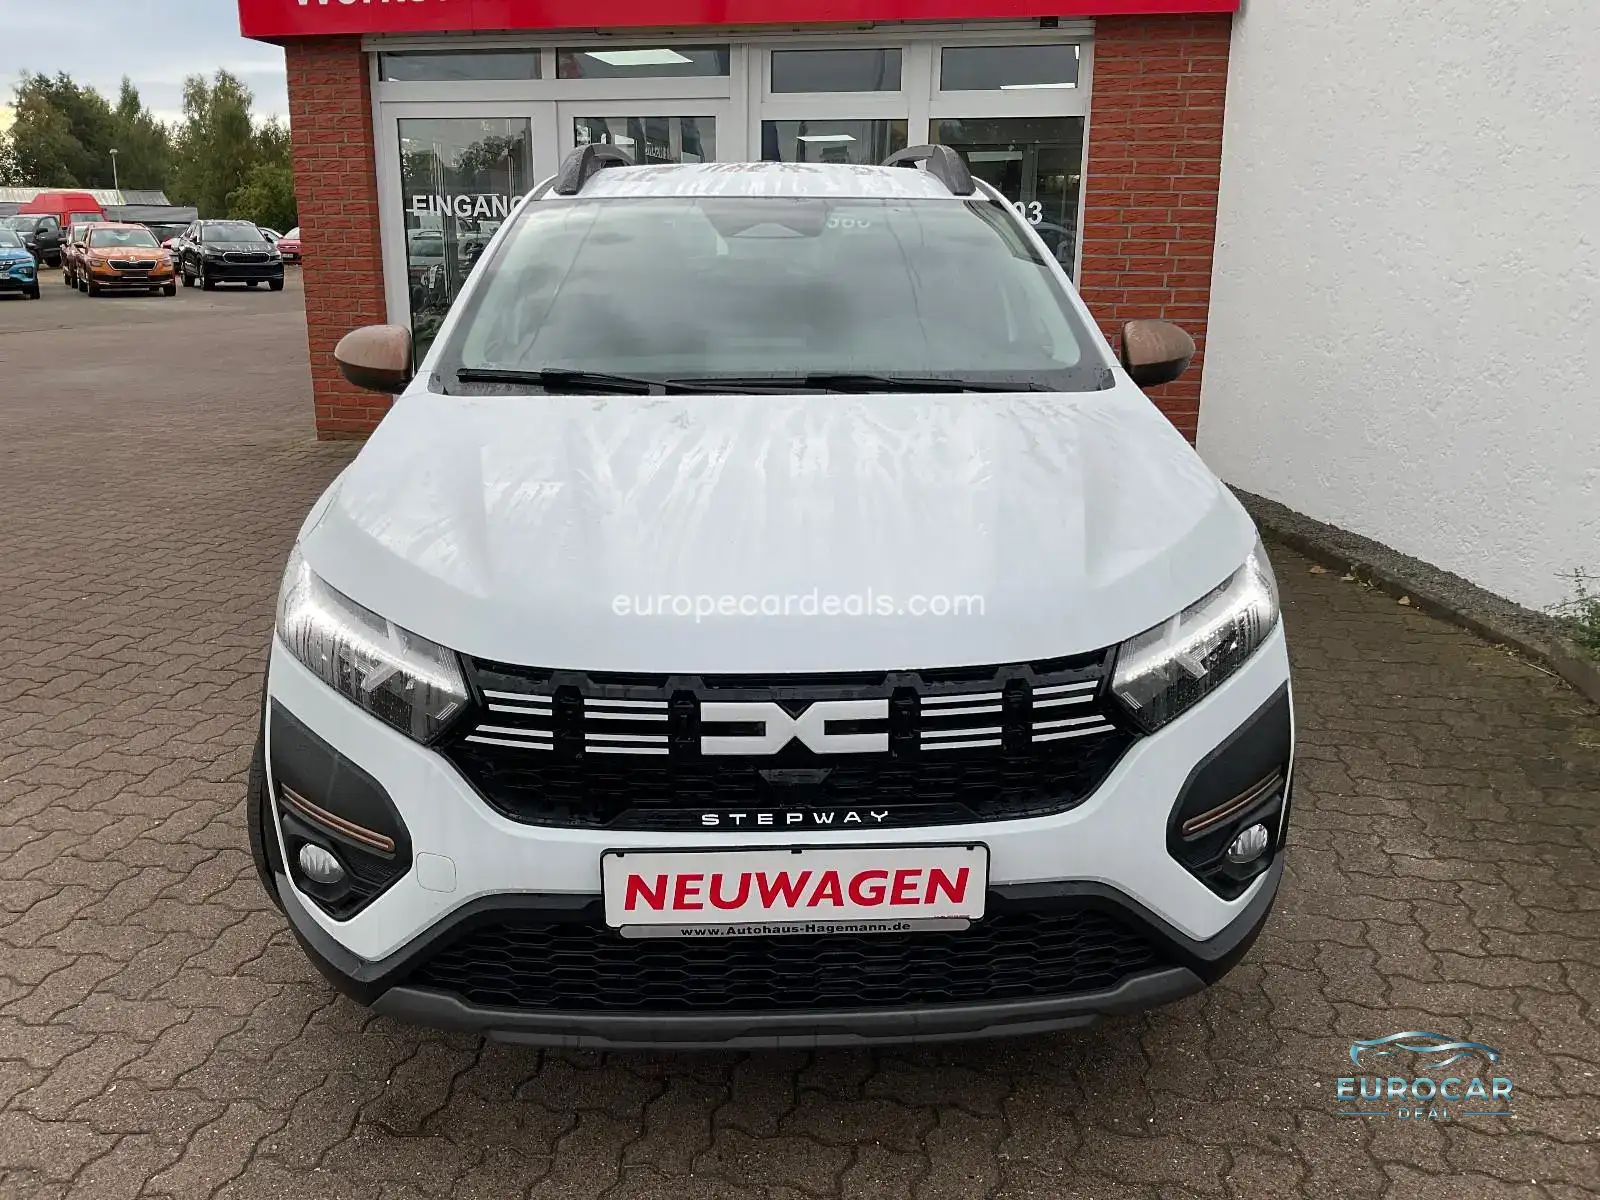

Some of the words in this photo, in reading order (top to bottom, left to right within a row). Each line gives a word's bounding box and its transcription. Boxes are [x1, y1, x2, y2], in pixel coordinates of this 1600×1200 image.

[701, 810, 889, 826] STEPWAY
[624, 867, 970, 911] NEUWAGEN
[680, 921, 911, 937] www.Autohaus-Hagemann.de
